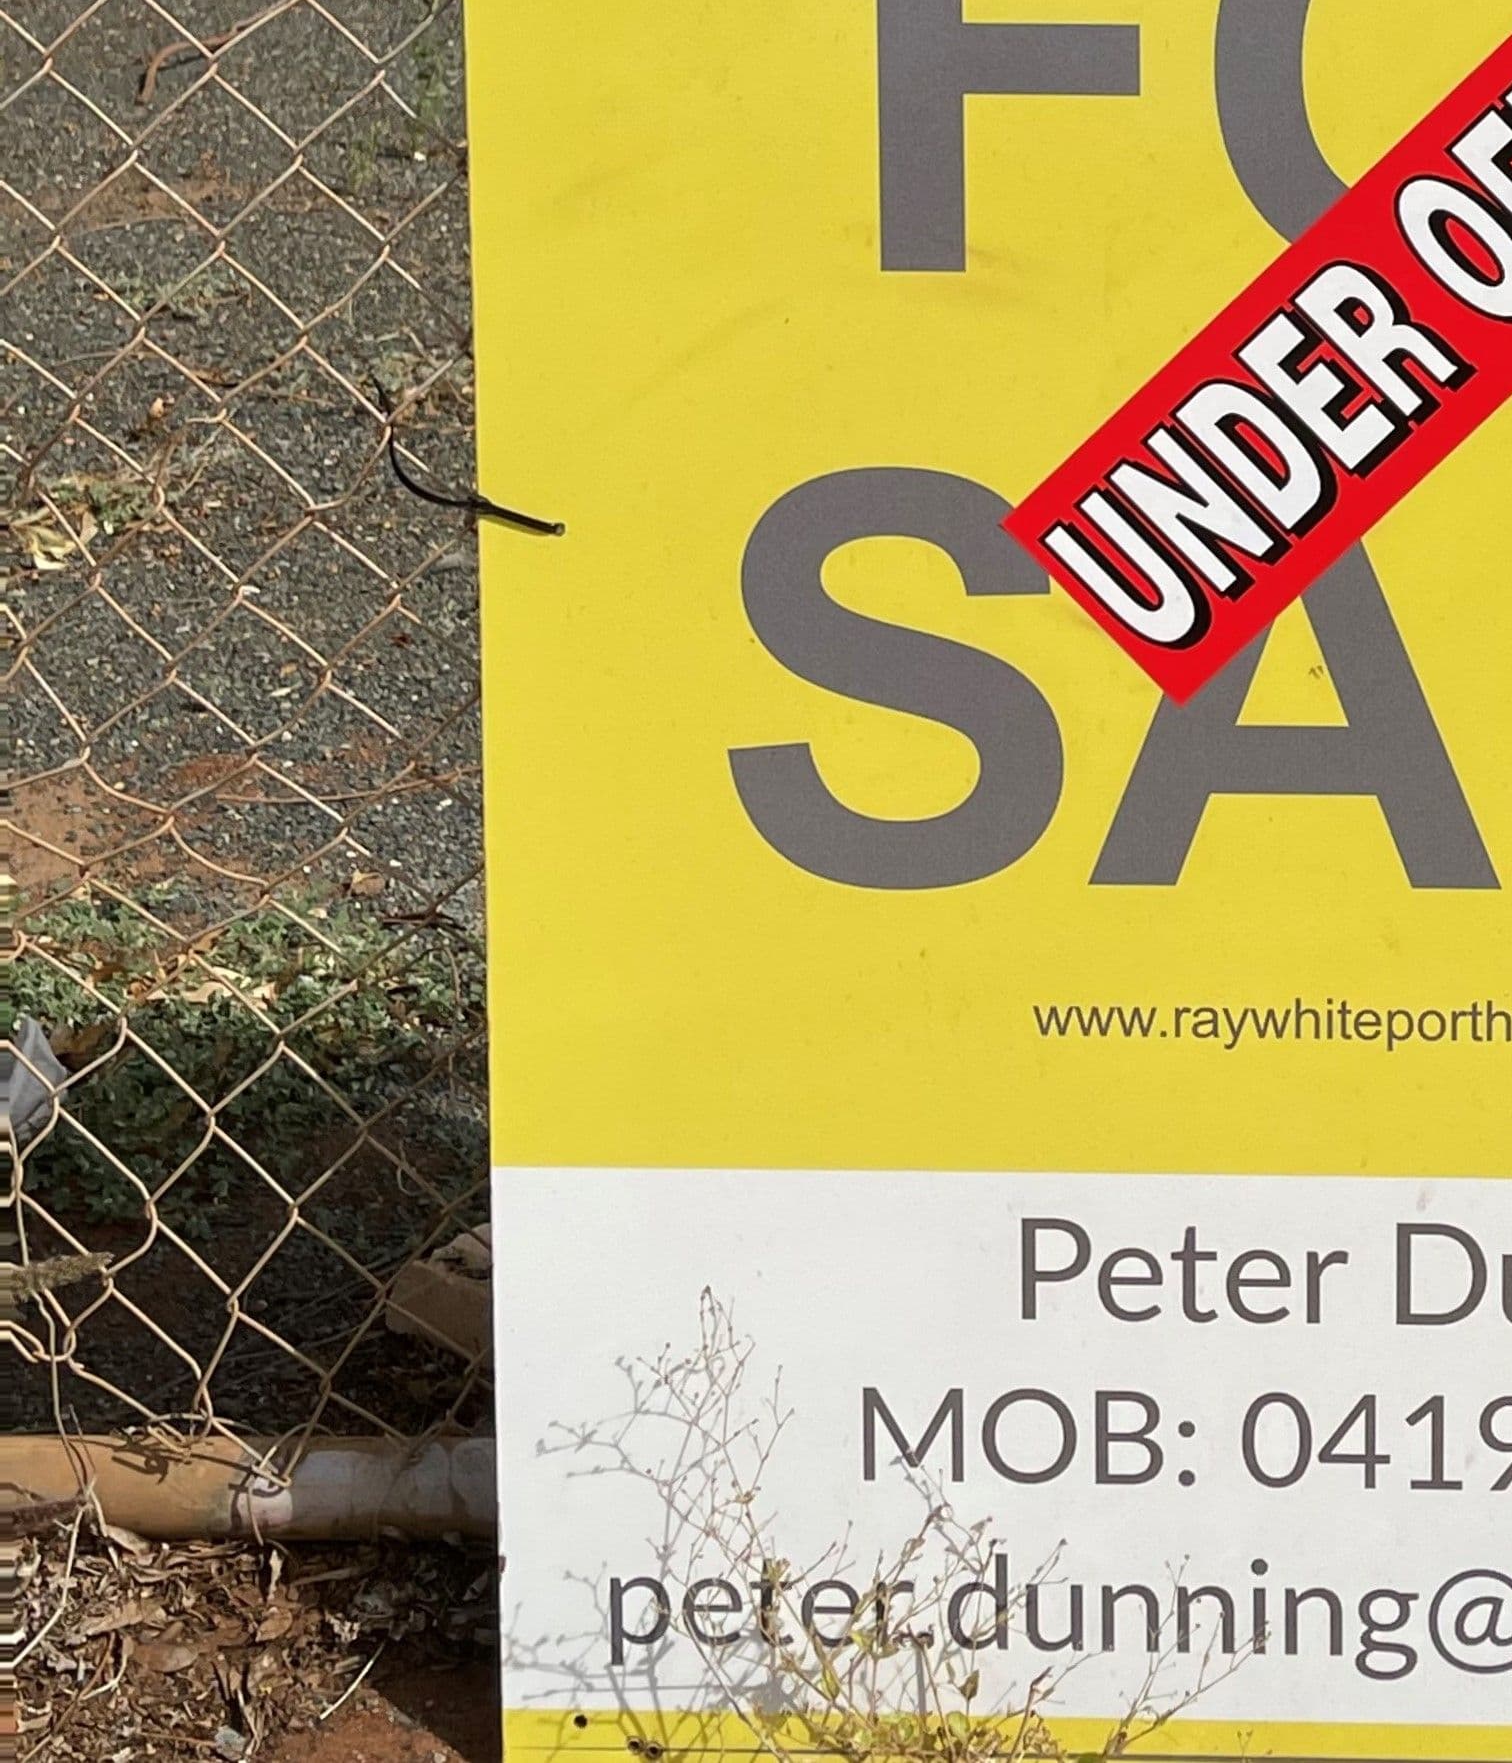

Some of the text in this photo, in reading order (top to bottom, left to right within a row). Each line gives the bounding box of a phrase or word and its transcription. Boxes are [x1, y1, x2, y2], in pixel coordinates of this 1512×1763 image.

[1042, 261, 1479, 651] UNDER
[1020, 1216, 1350, 1325] Peter
[861, 1386, 1197, 1488] MOB:
